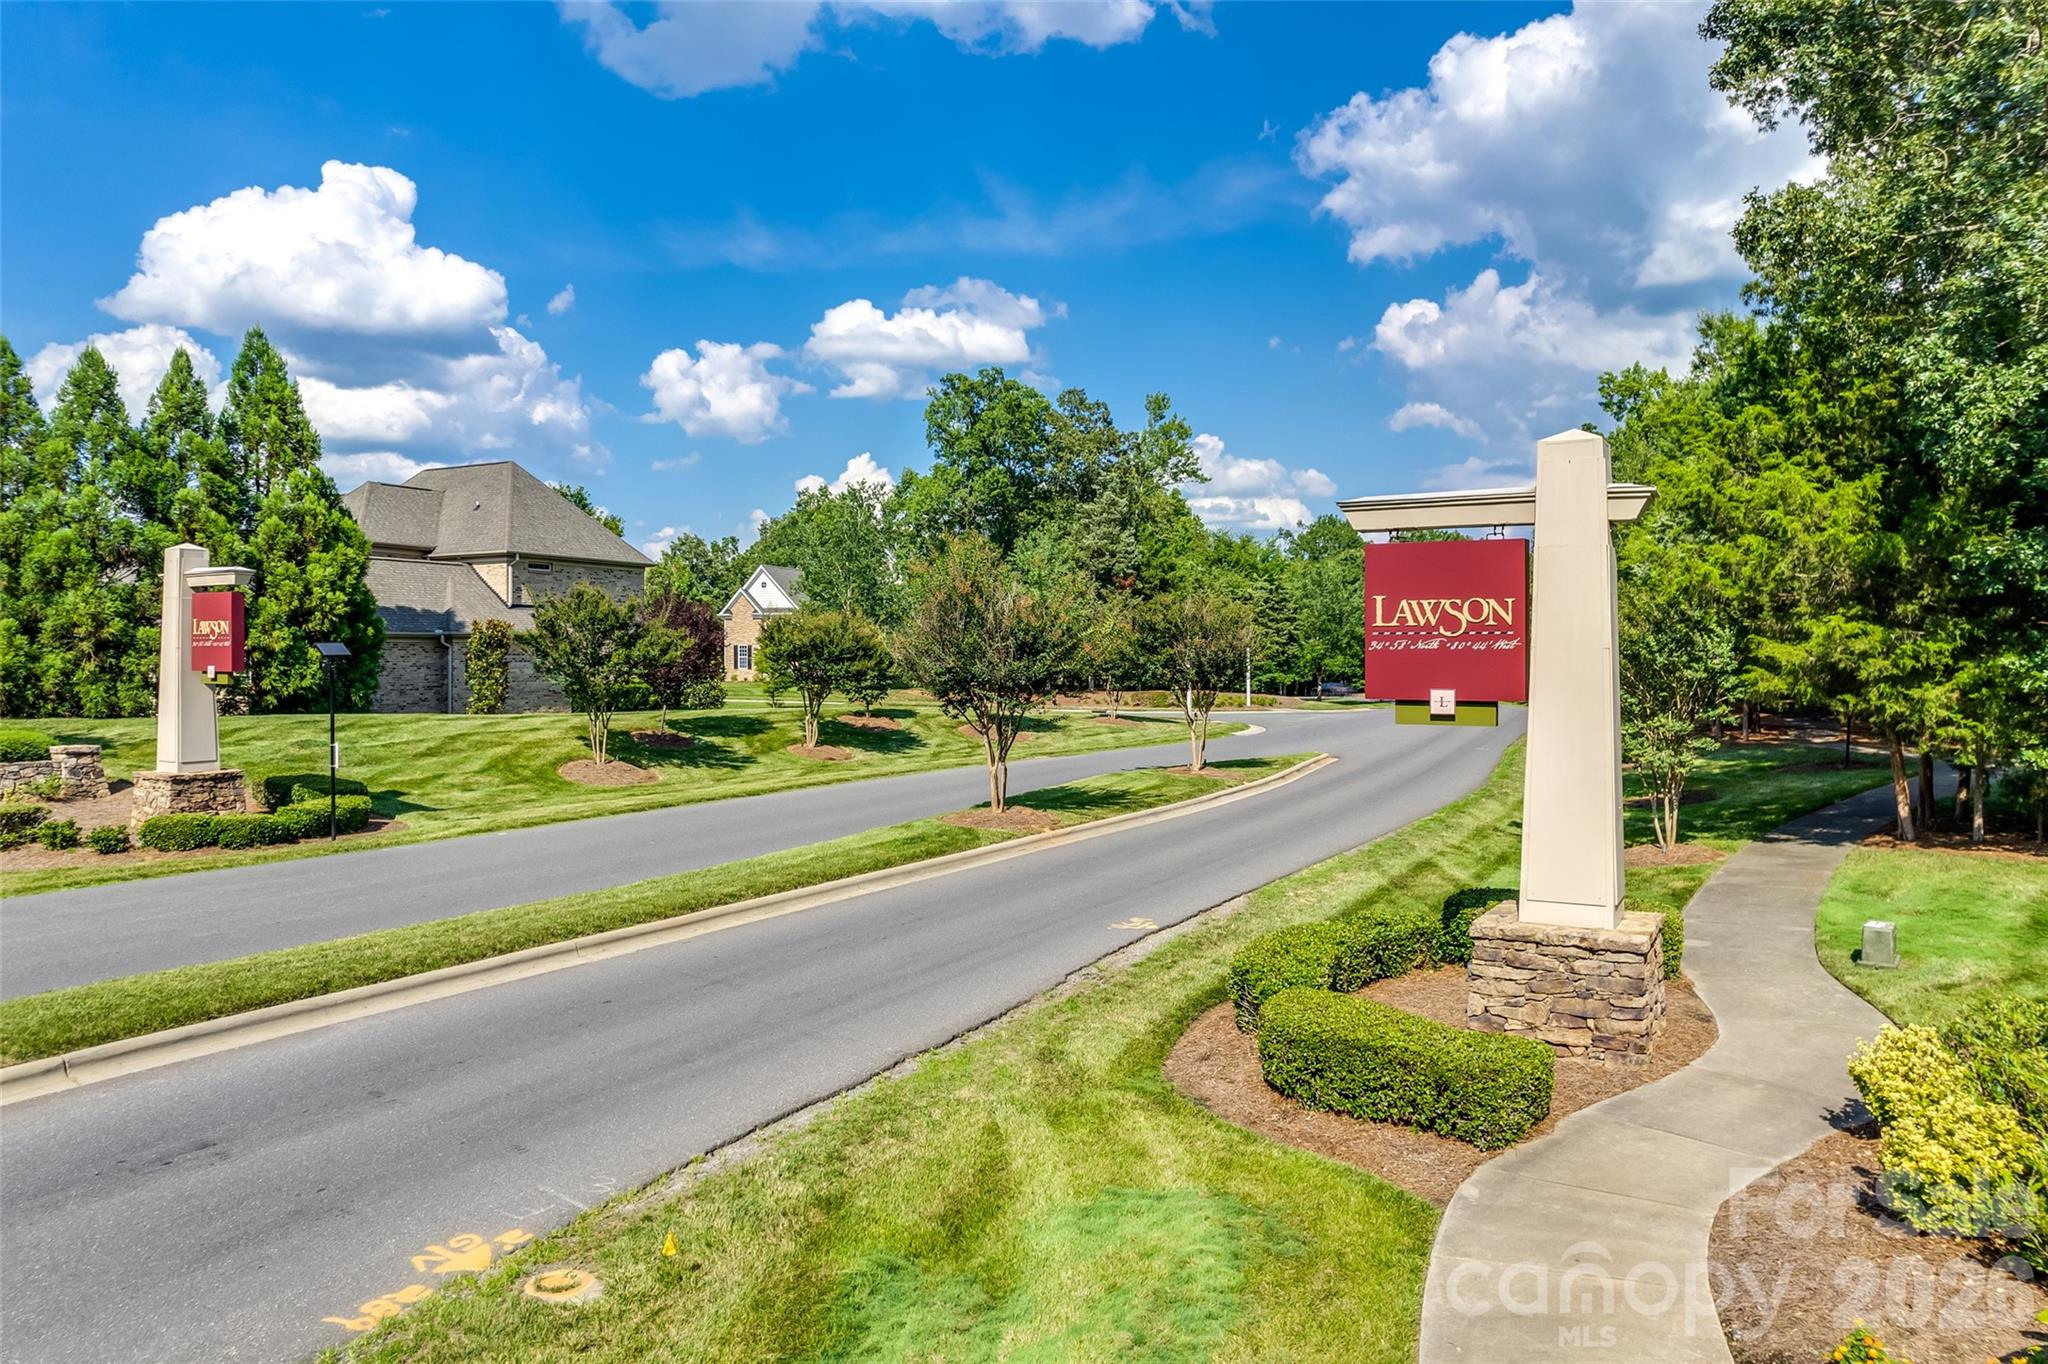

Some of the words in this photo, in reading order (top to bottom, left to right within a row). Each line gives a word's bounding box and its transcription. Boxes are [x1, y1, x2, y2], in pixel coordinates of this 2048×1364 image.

[1372, 595, 1516, 637] LAWSON
[192, 619, 229, 640] LAWSON
[1439, 696, 1449, 708] L
